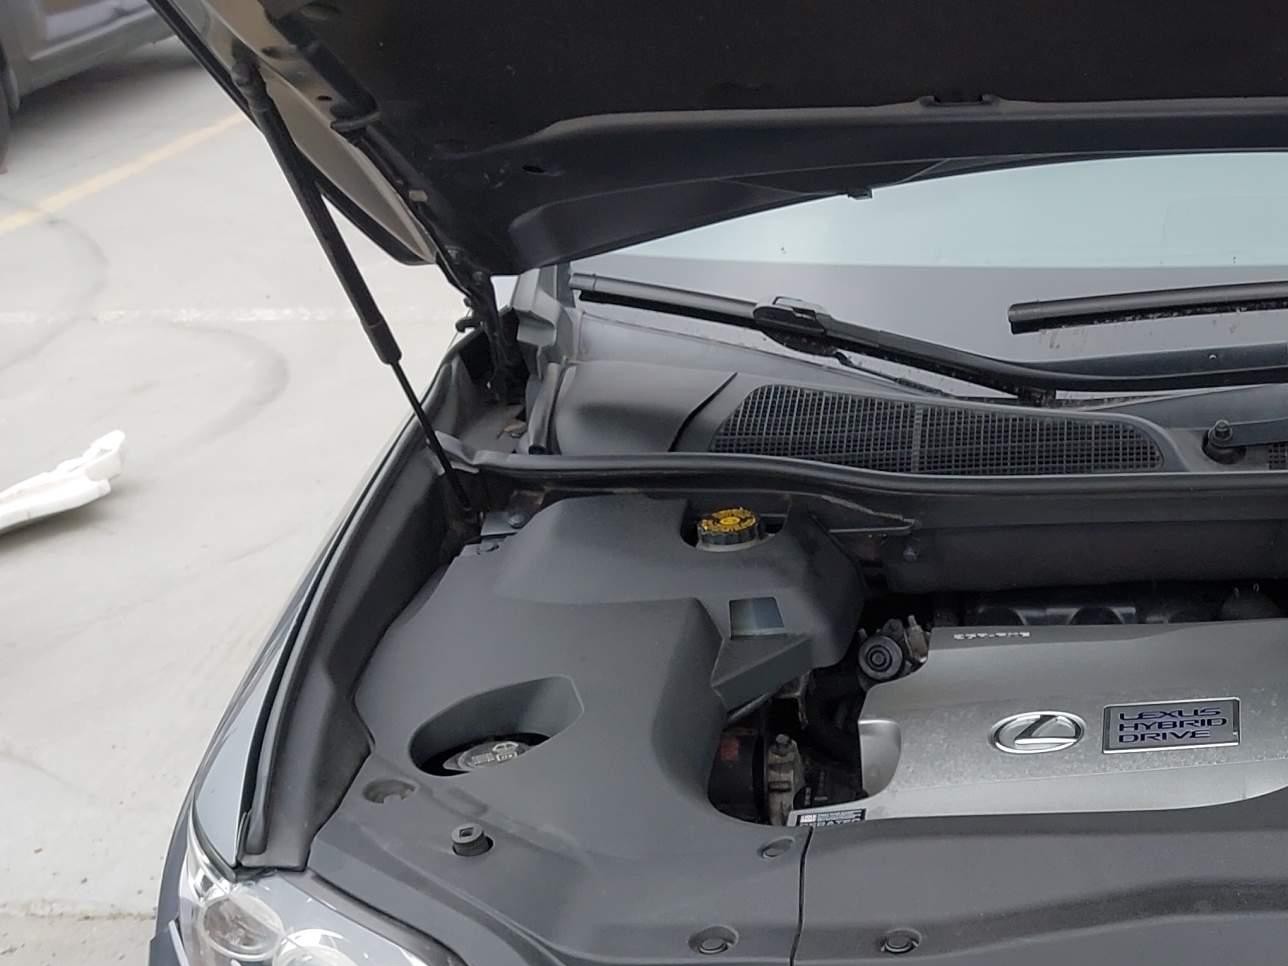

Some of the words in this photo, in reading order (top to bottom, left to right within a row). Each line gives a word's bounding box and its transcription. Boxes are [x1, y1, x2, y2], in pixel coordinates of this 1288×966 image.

[1119, 707, 1221, 720] LEXUS
[1119, 718, 1228, 732] HYBRID
[1118, 730, 1211, 743] DRIVE
